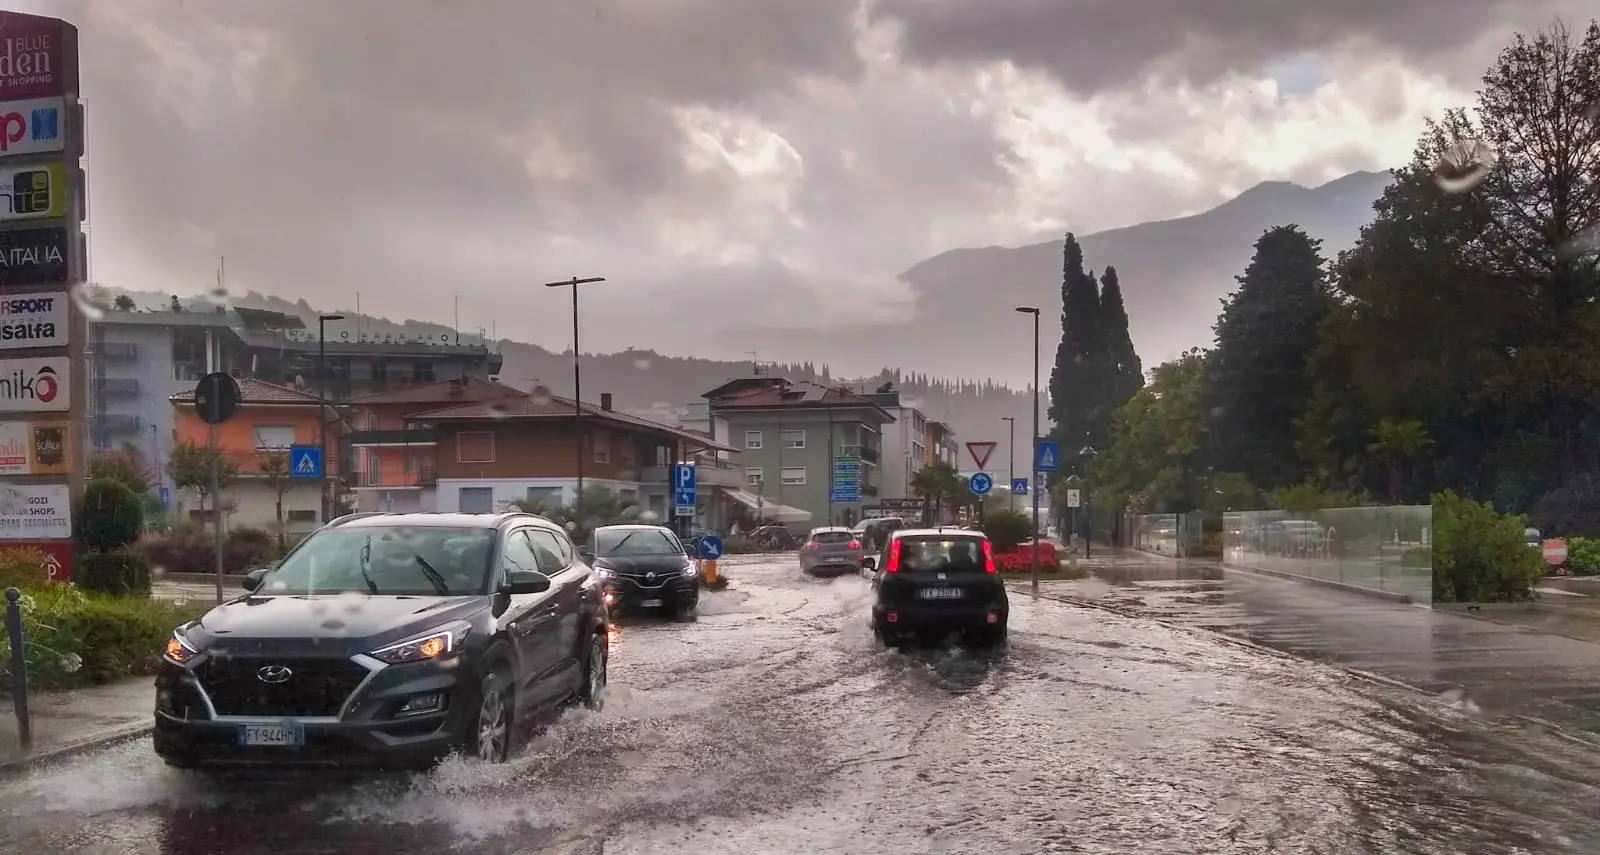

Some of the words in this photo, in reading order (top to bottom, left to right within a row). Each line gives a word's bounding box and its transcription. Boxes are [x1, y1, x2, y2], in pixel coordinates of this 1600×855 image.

[16, 34, 50, 52] BLUE
[0, 38, 52, 77] den
[7, 74, 53, 87] SHOPPING
[10, 246, 63, 267] ITALIA
[0, 323, 55, 340] salfa
[680, 467, 691, 488] P
[29, 507, 56, 516] SHOPS
